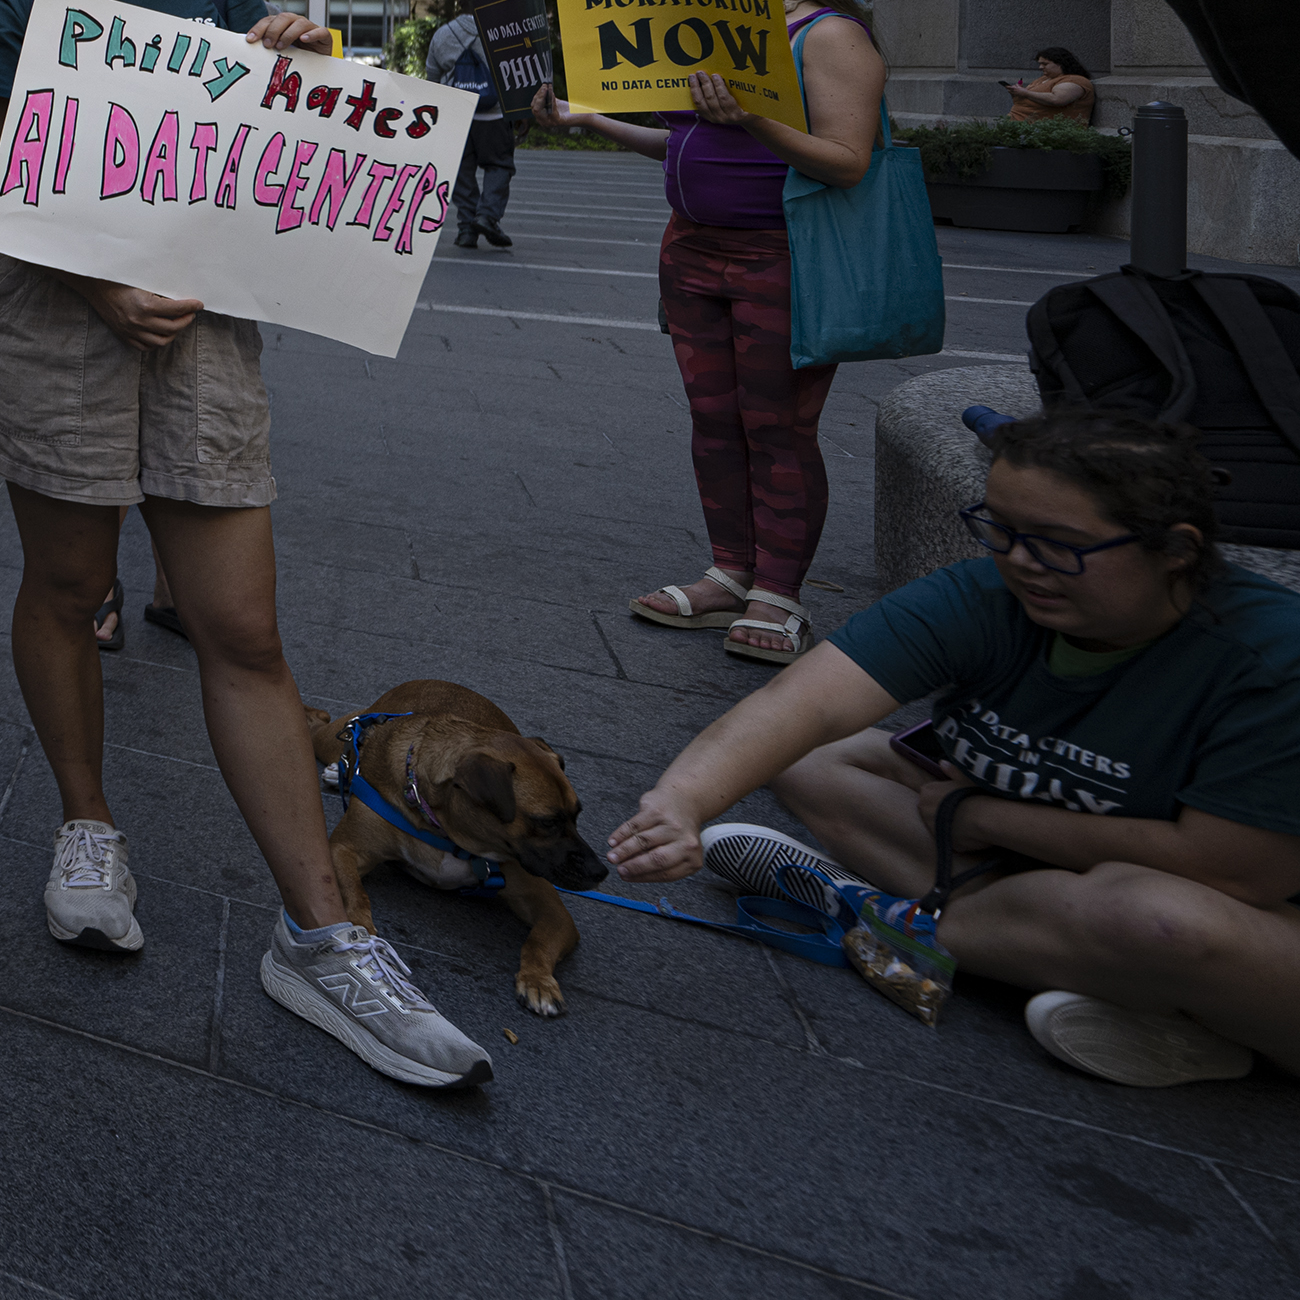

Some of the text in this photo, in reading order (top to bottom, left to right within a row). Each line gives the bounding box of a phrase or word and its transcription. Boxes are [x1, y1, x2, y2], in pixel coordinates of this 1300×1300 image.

[486, 26, 500, 42] NO
[500, 21, 523, 39] DATA
[594, 16, 771, 77] NOW
[59, 6, 439, 140] Philly hates
[601, 80, 618, 91] NO
[622, 79, 652, 90] DATA
[656, 77, 690, 89] CENT
[728, 79, 757, 94] PHILLY
[0, 88, 451, 256] AI DATA CENTERS
[1018, 750, 1041, 767] IN
